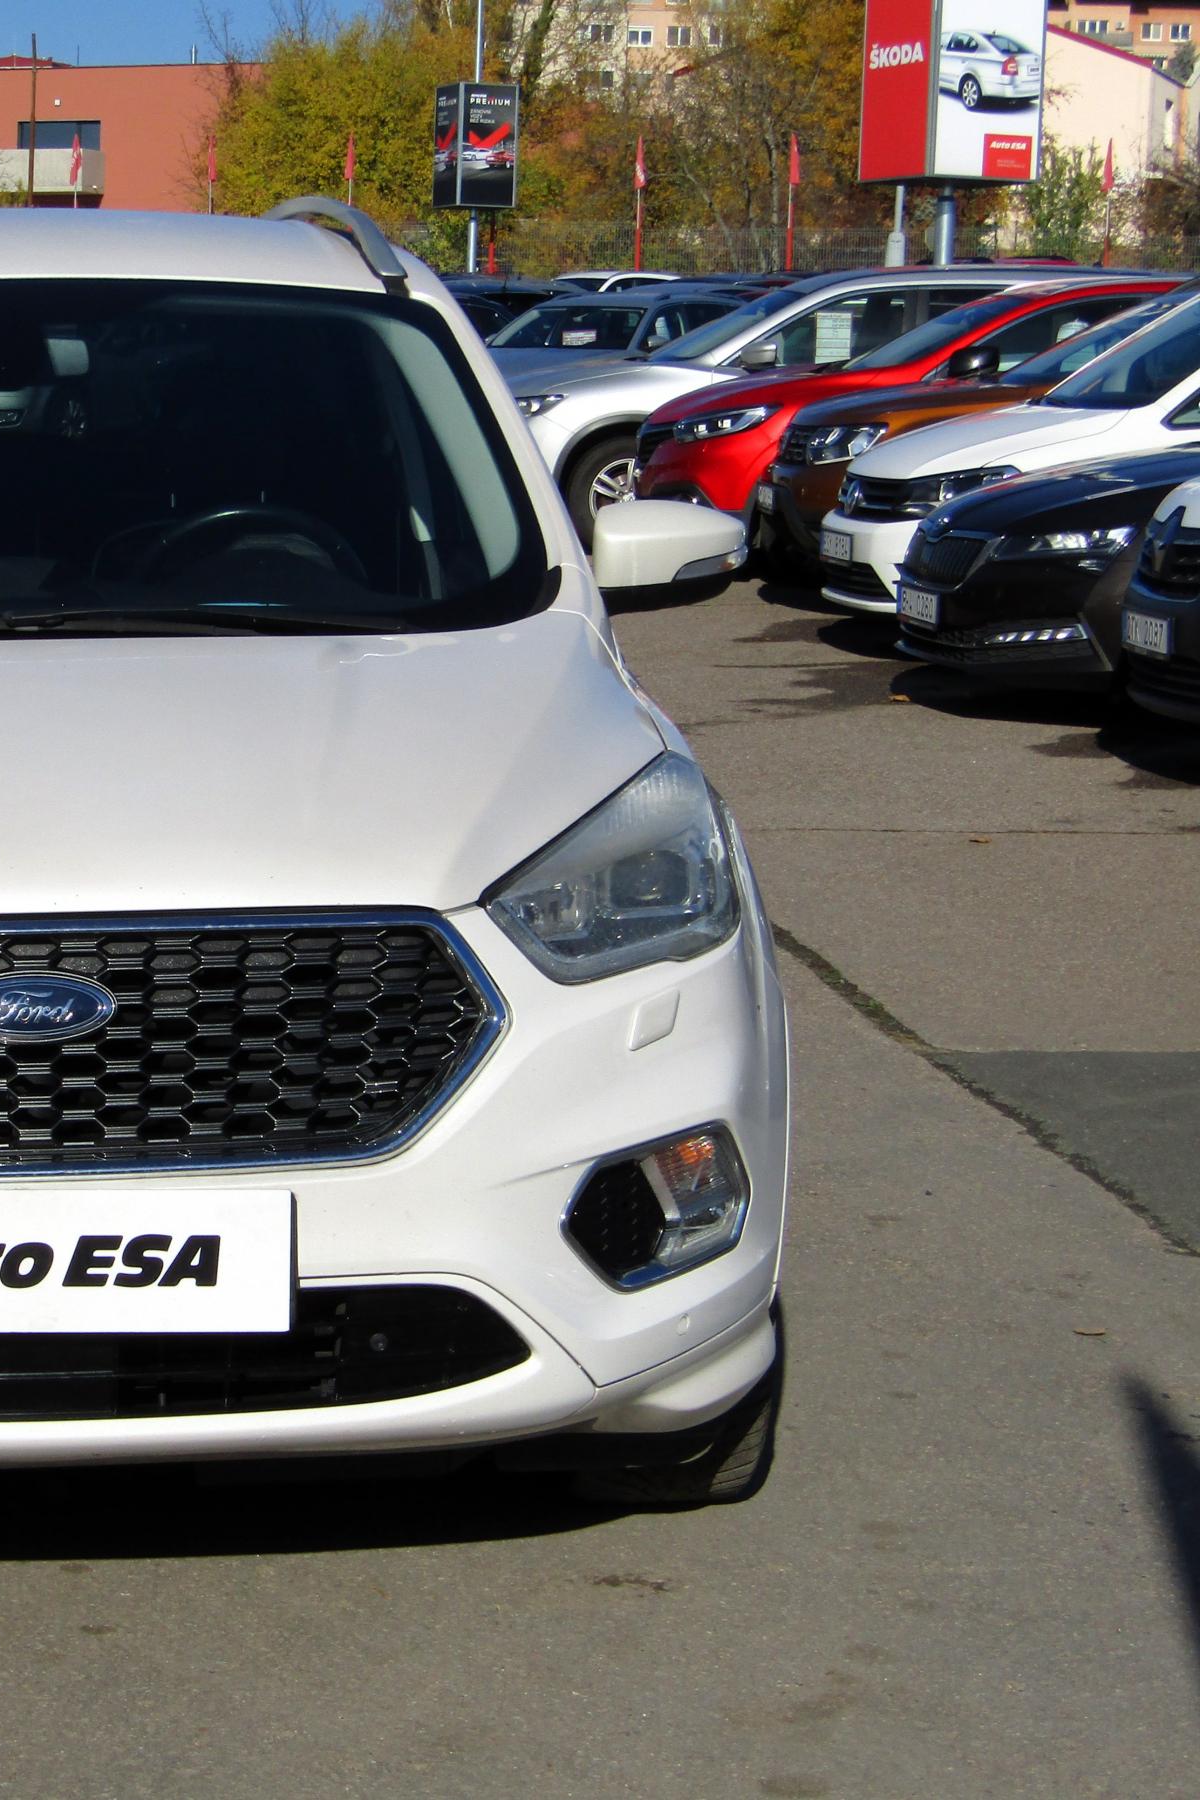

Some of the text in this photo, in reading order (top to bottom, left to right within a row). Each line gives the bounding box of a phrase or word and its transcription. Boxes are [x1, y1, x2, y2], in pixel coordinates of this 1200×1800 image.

[869, 42, 924, 70] ŠKODA
[470, 97, 511, 106] PREMIUM
[990, 141, 1027, 151] Auto ESA
[917, 594, 934, 619] 0260
[1143, 620, 1163, 648] 2087
[62, 1233, 221, 1288] ESA
